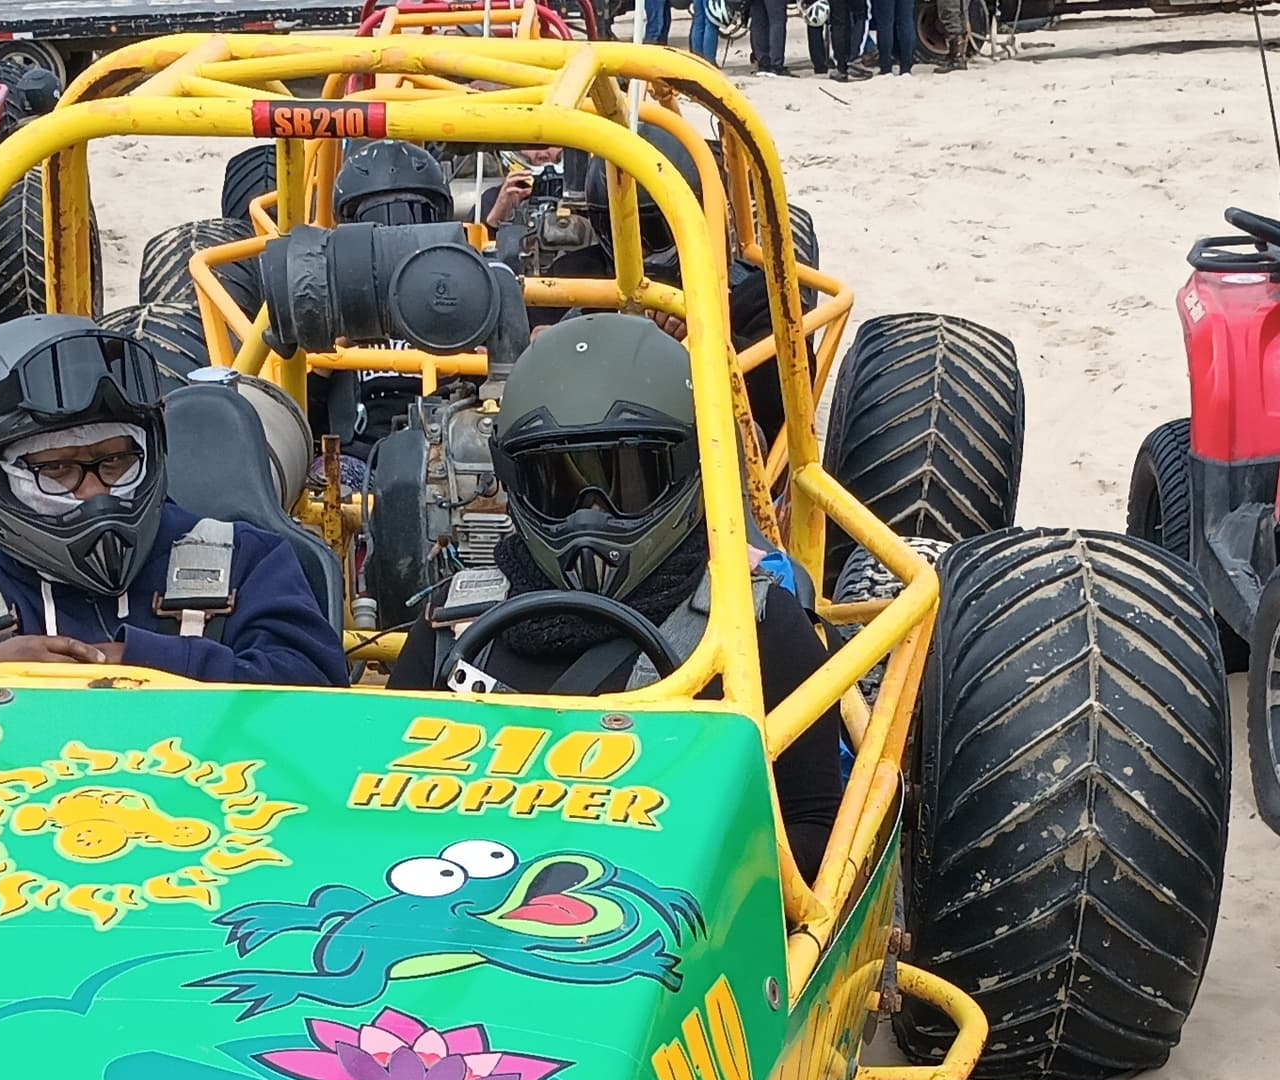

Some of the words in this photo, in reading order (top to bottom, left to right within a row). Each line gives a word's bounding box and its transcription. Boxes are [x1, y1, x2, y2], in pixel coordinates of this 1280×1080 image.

[273, 106, 365, 137] SB210
[390, 717, 641, 782] 210
[351, 773, 665, 829] HOPPER
